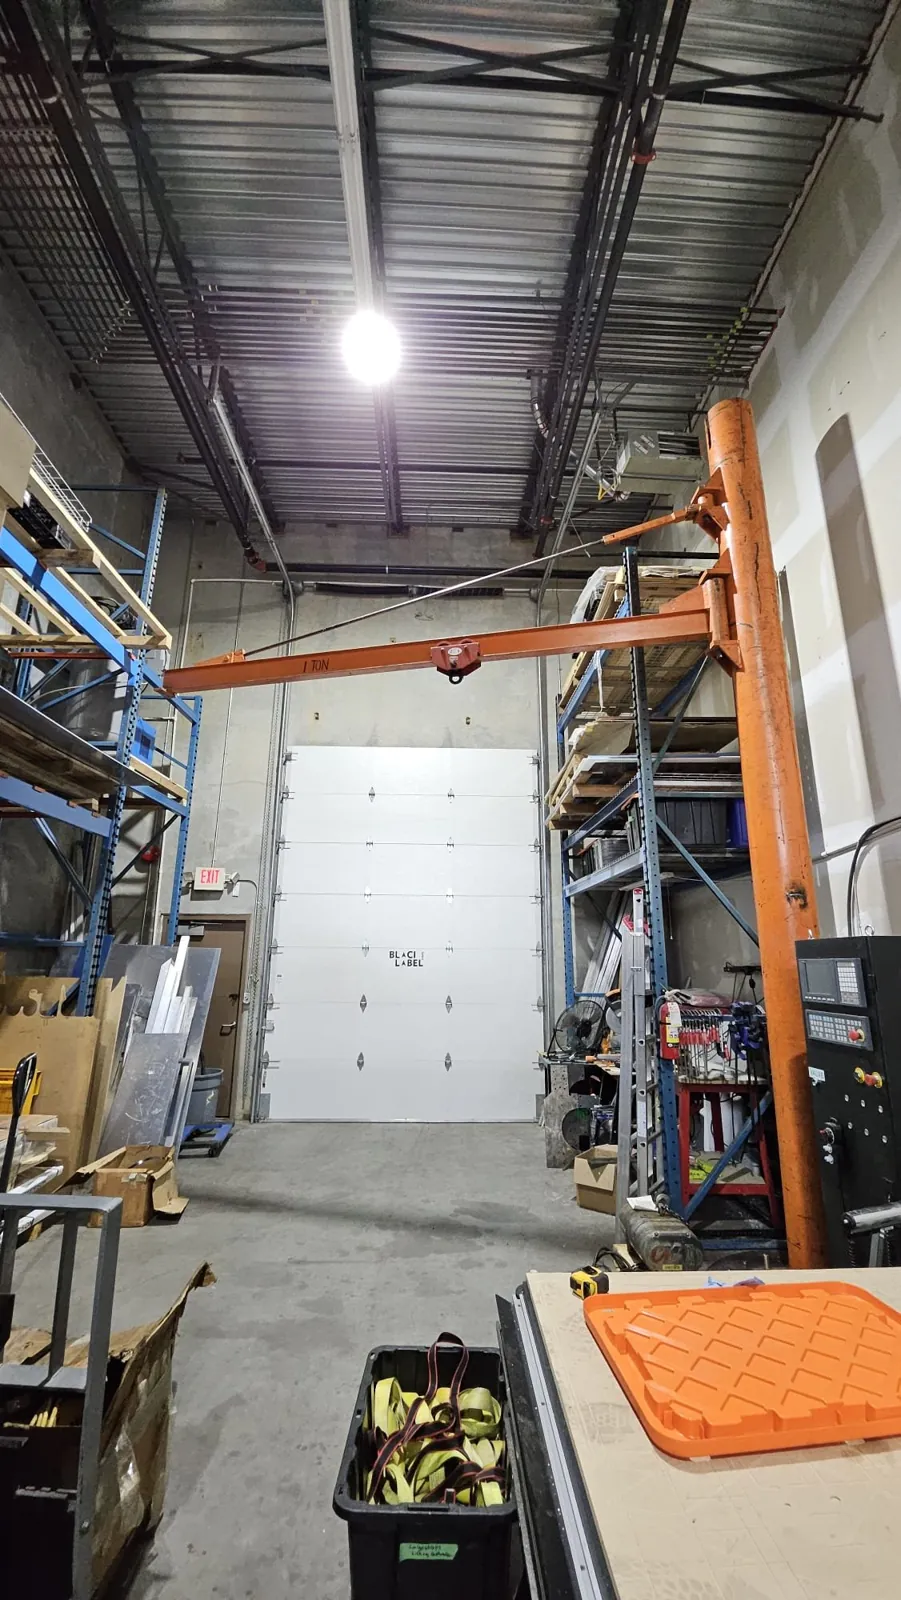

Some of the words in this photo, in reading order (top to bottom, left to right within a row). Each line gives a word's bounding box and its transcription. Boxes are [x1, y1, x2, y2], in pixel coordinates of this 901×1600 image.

[311, 657, 330, 672] TON
[200, 869, 220, 884] EXIT
[395, 959, 424, 967] LABEL
